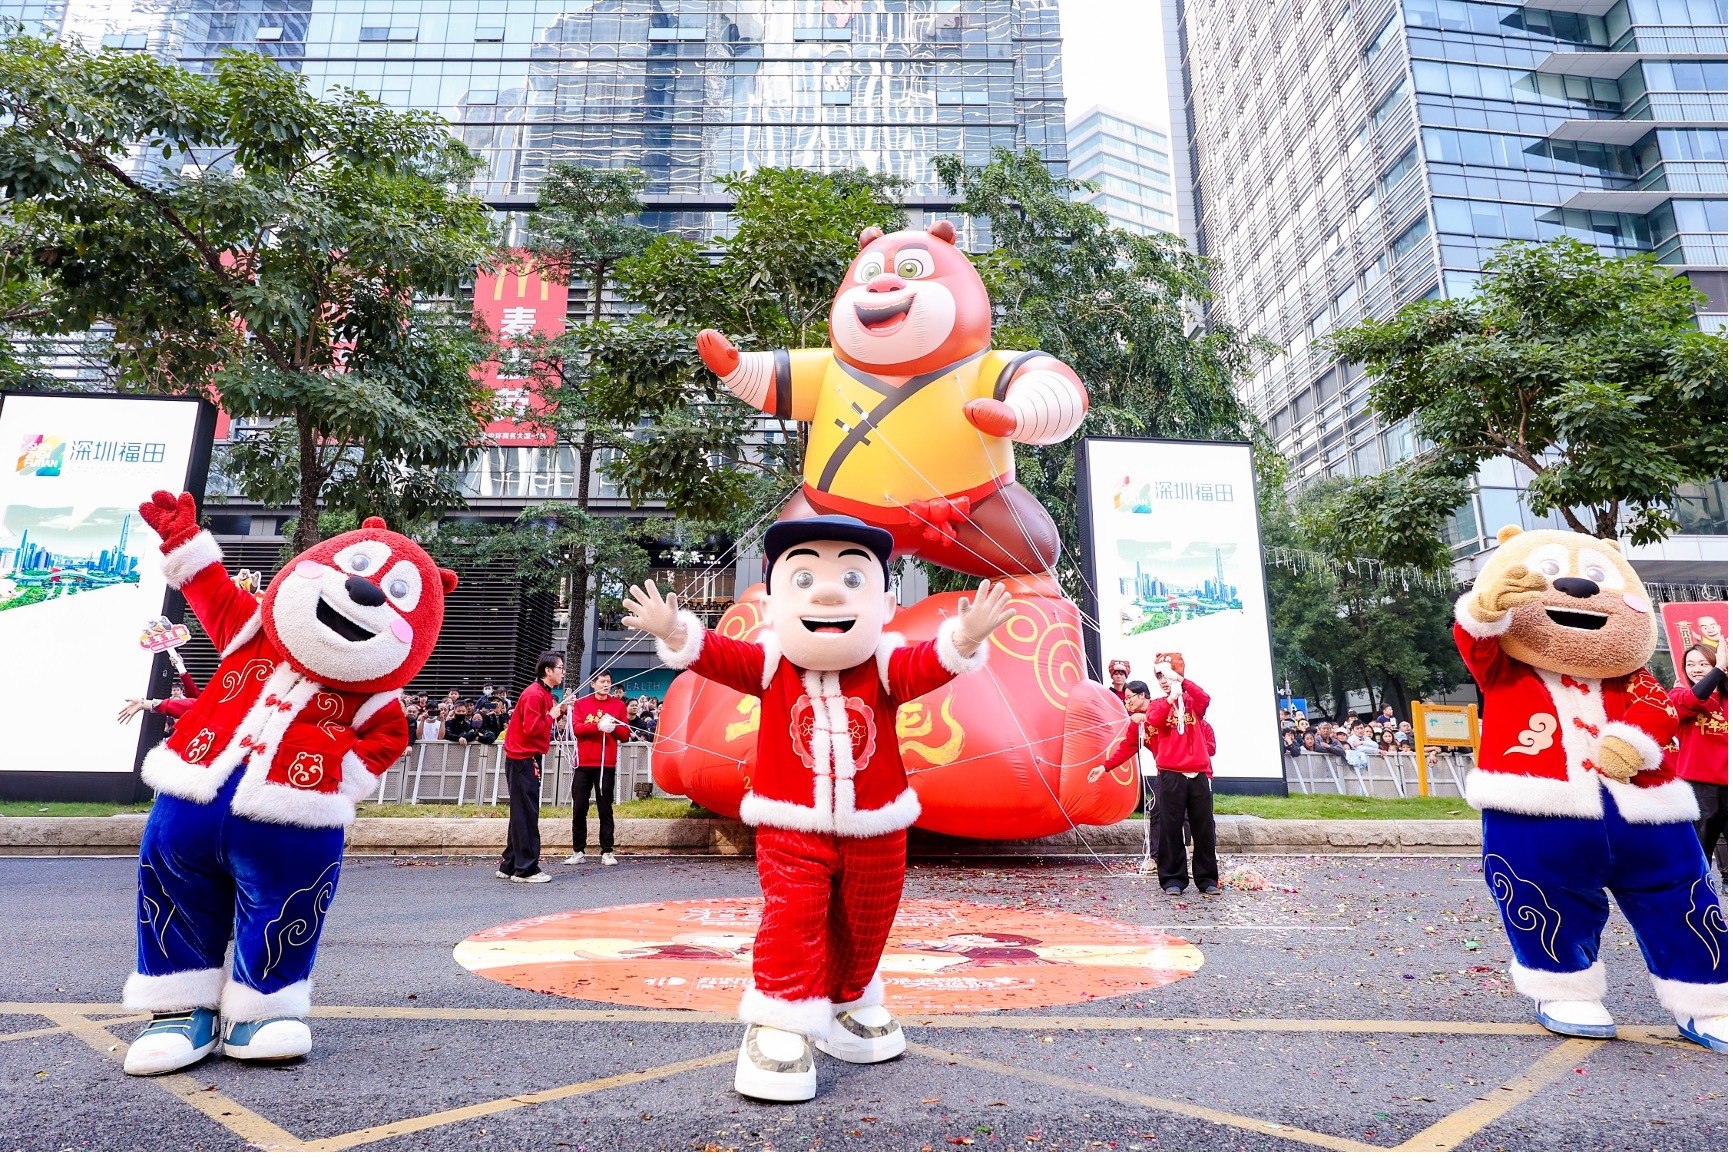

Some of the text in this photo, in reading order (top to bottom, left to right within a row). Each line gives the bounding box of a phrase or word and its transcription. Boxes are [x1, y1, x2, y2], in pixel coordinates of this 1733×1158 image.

[69, 440, 166, 463] 深圳福田
[1154, 481, 1234, 502] 深圳福田
